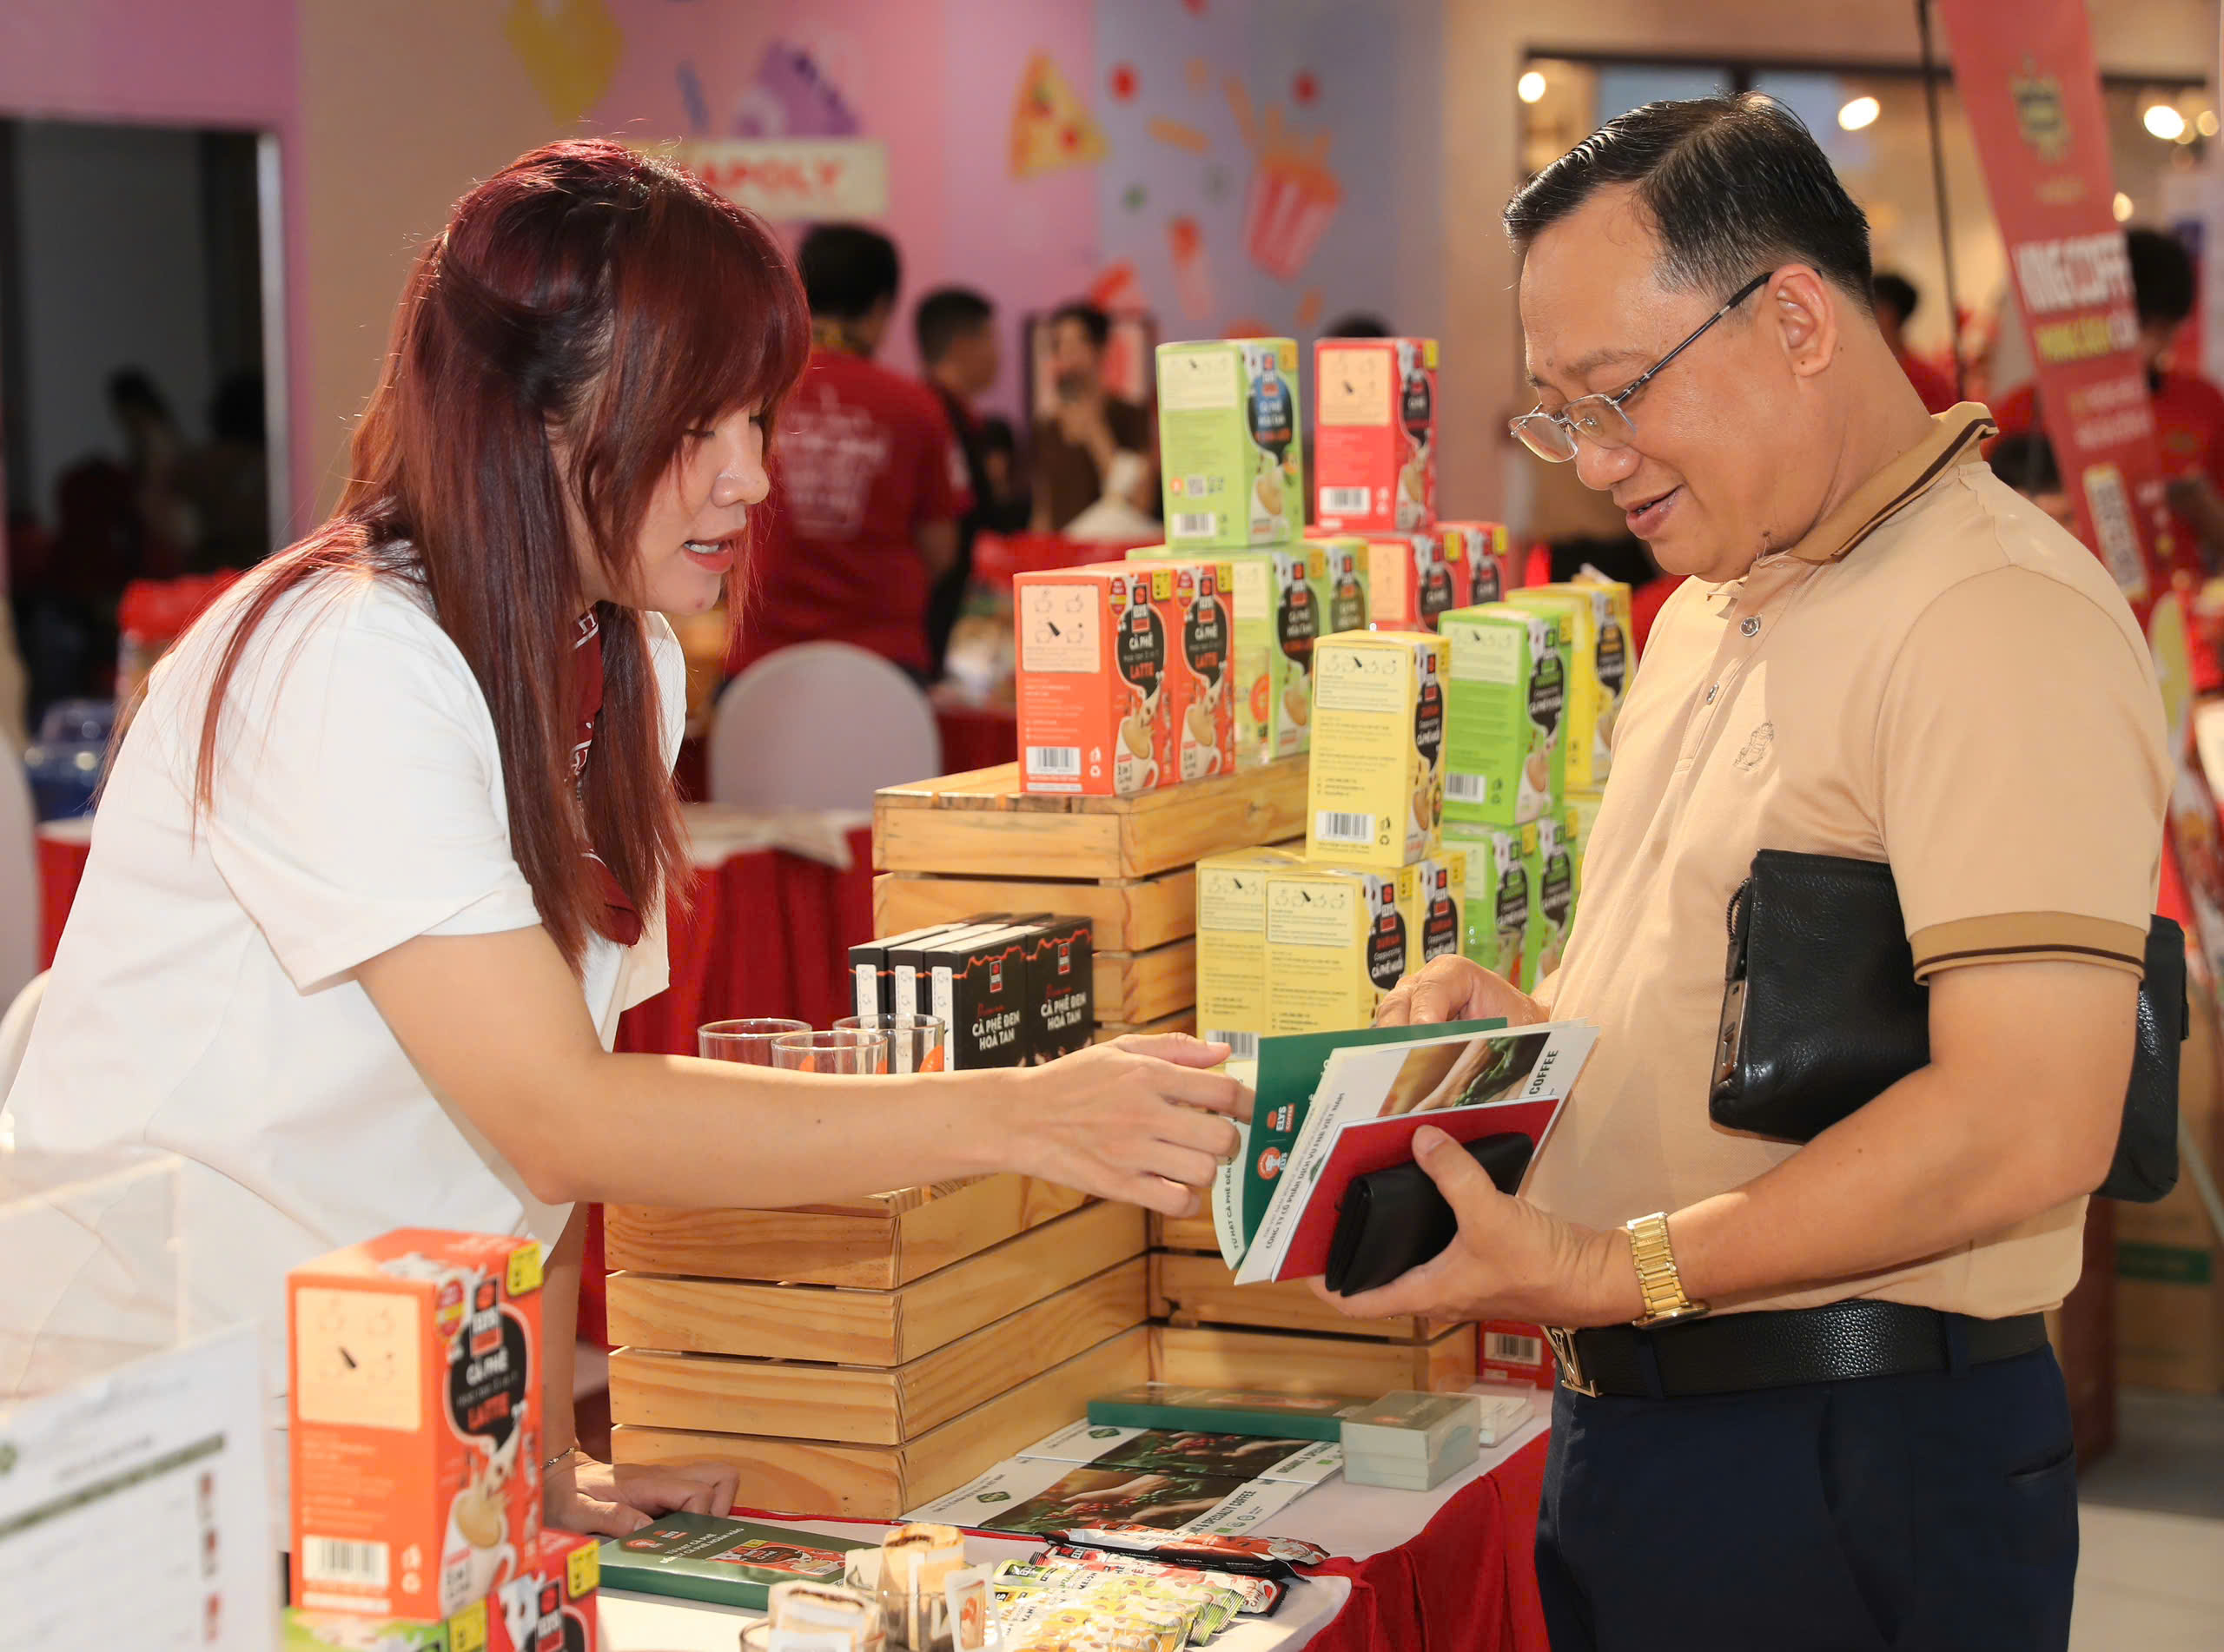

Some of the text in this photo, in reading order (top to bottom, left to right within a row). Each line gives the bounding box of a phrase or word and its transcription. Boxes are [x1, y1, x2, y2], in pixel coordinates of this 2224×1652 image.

[1040, 998, 1053, 1018] CÀ
[1053, 993, 1070, 1015] PHÊ
[971, 1009, 1022, 1037] CÀ PHÊ ĐEN
[1046, 1008, 1082, 1031] HOÀ TAN
[978, 1027, 1016, 1051] HOÀ TAN
[1529, 1050, 1559, 1094] COFFEE
[1276, 1106, 1287, 1132] ELYS
[1203, 1502, 1235, 1527] SPECIALTY
[1232, 1489, 1257, 1508] COFFEE
